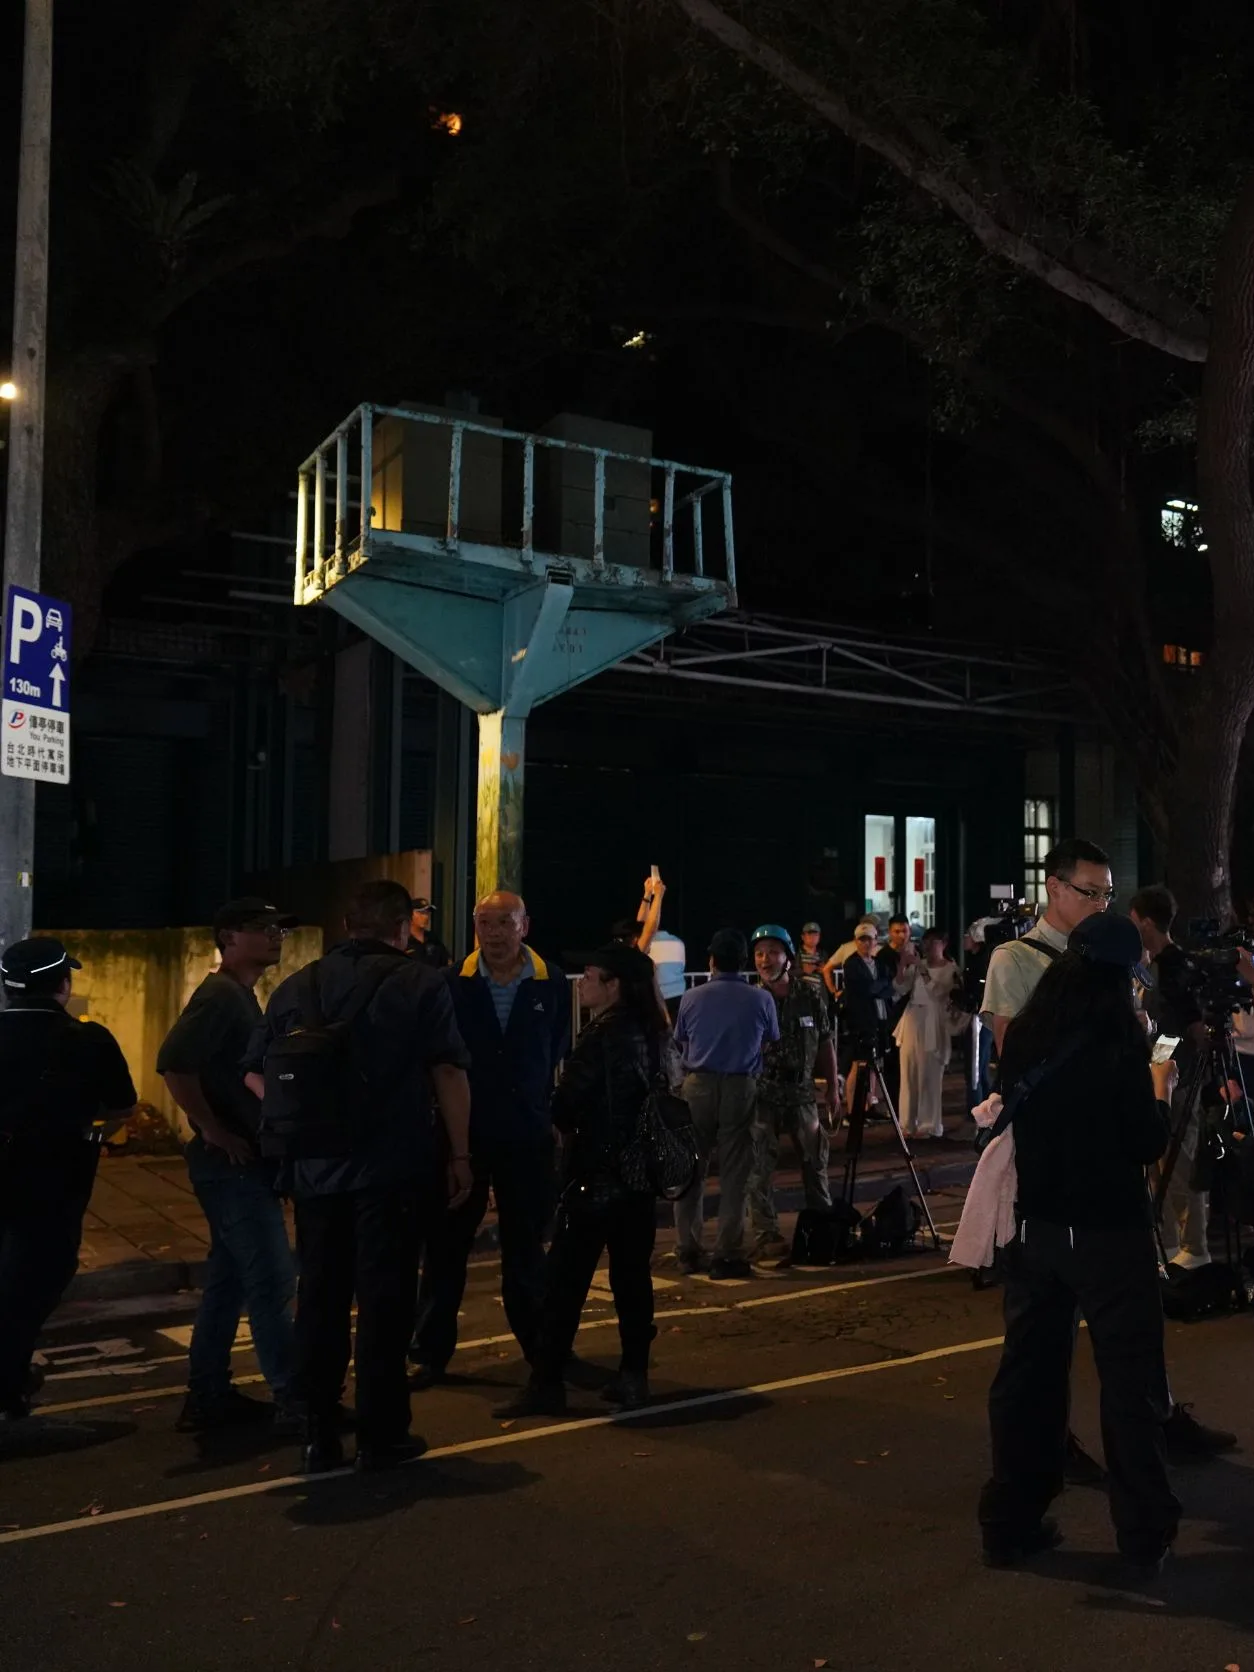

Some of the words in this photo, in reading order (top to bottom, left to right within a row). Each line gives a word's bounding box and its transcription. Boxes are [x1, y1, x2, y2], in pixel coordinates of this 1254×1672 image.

[10, 595, 43, 664] P
[9, 677, 41, 698] 130m
[43, 733, 64, 747] Parking
